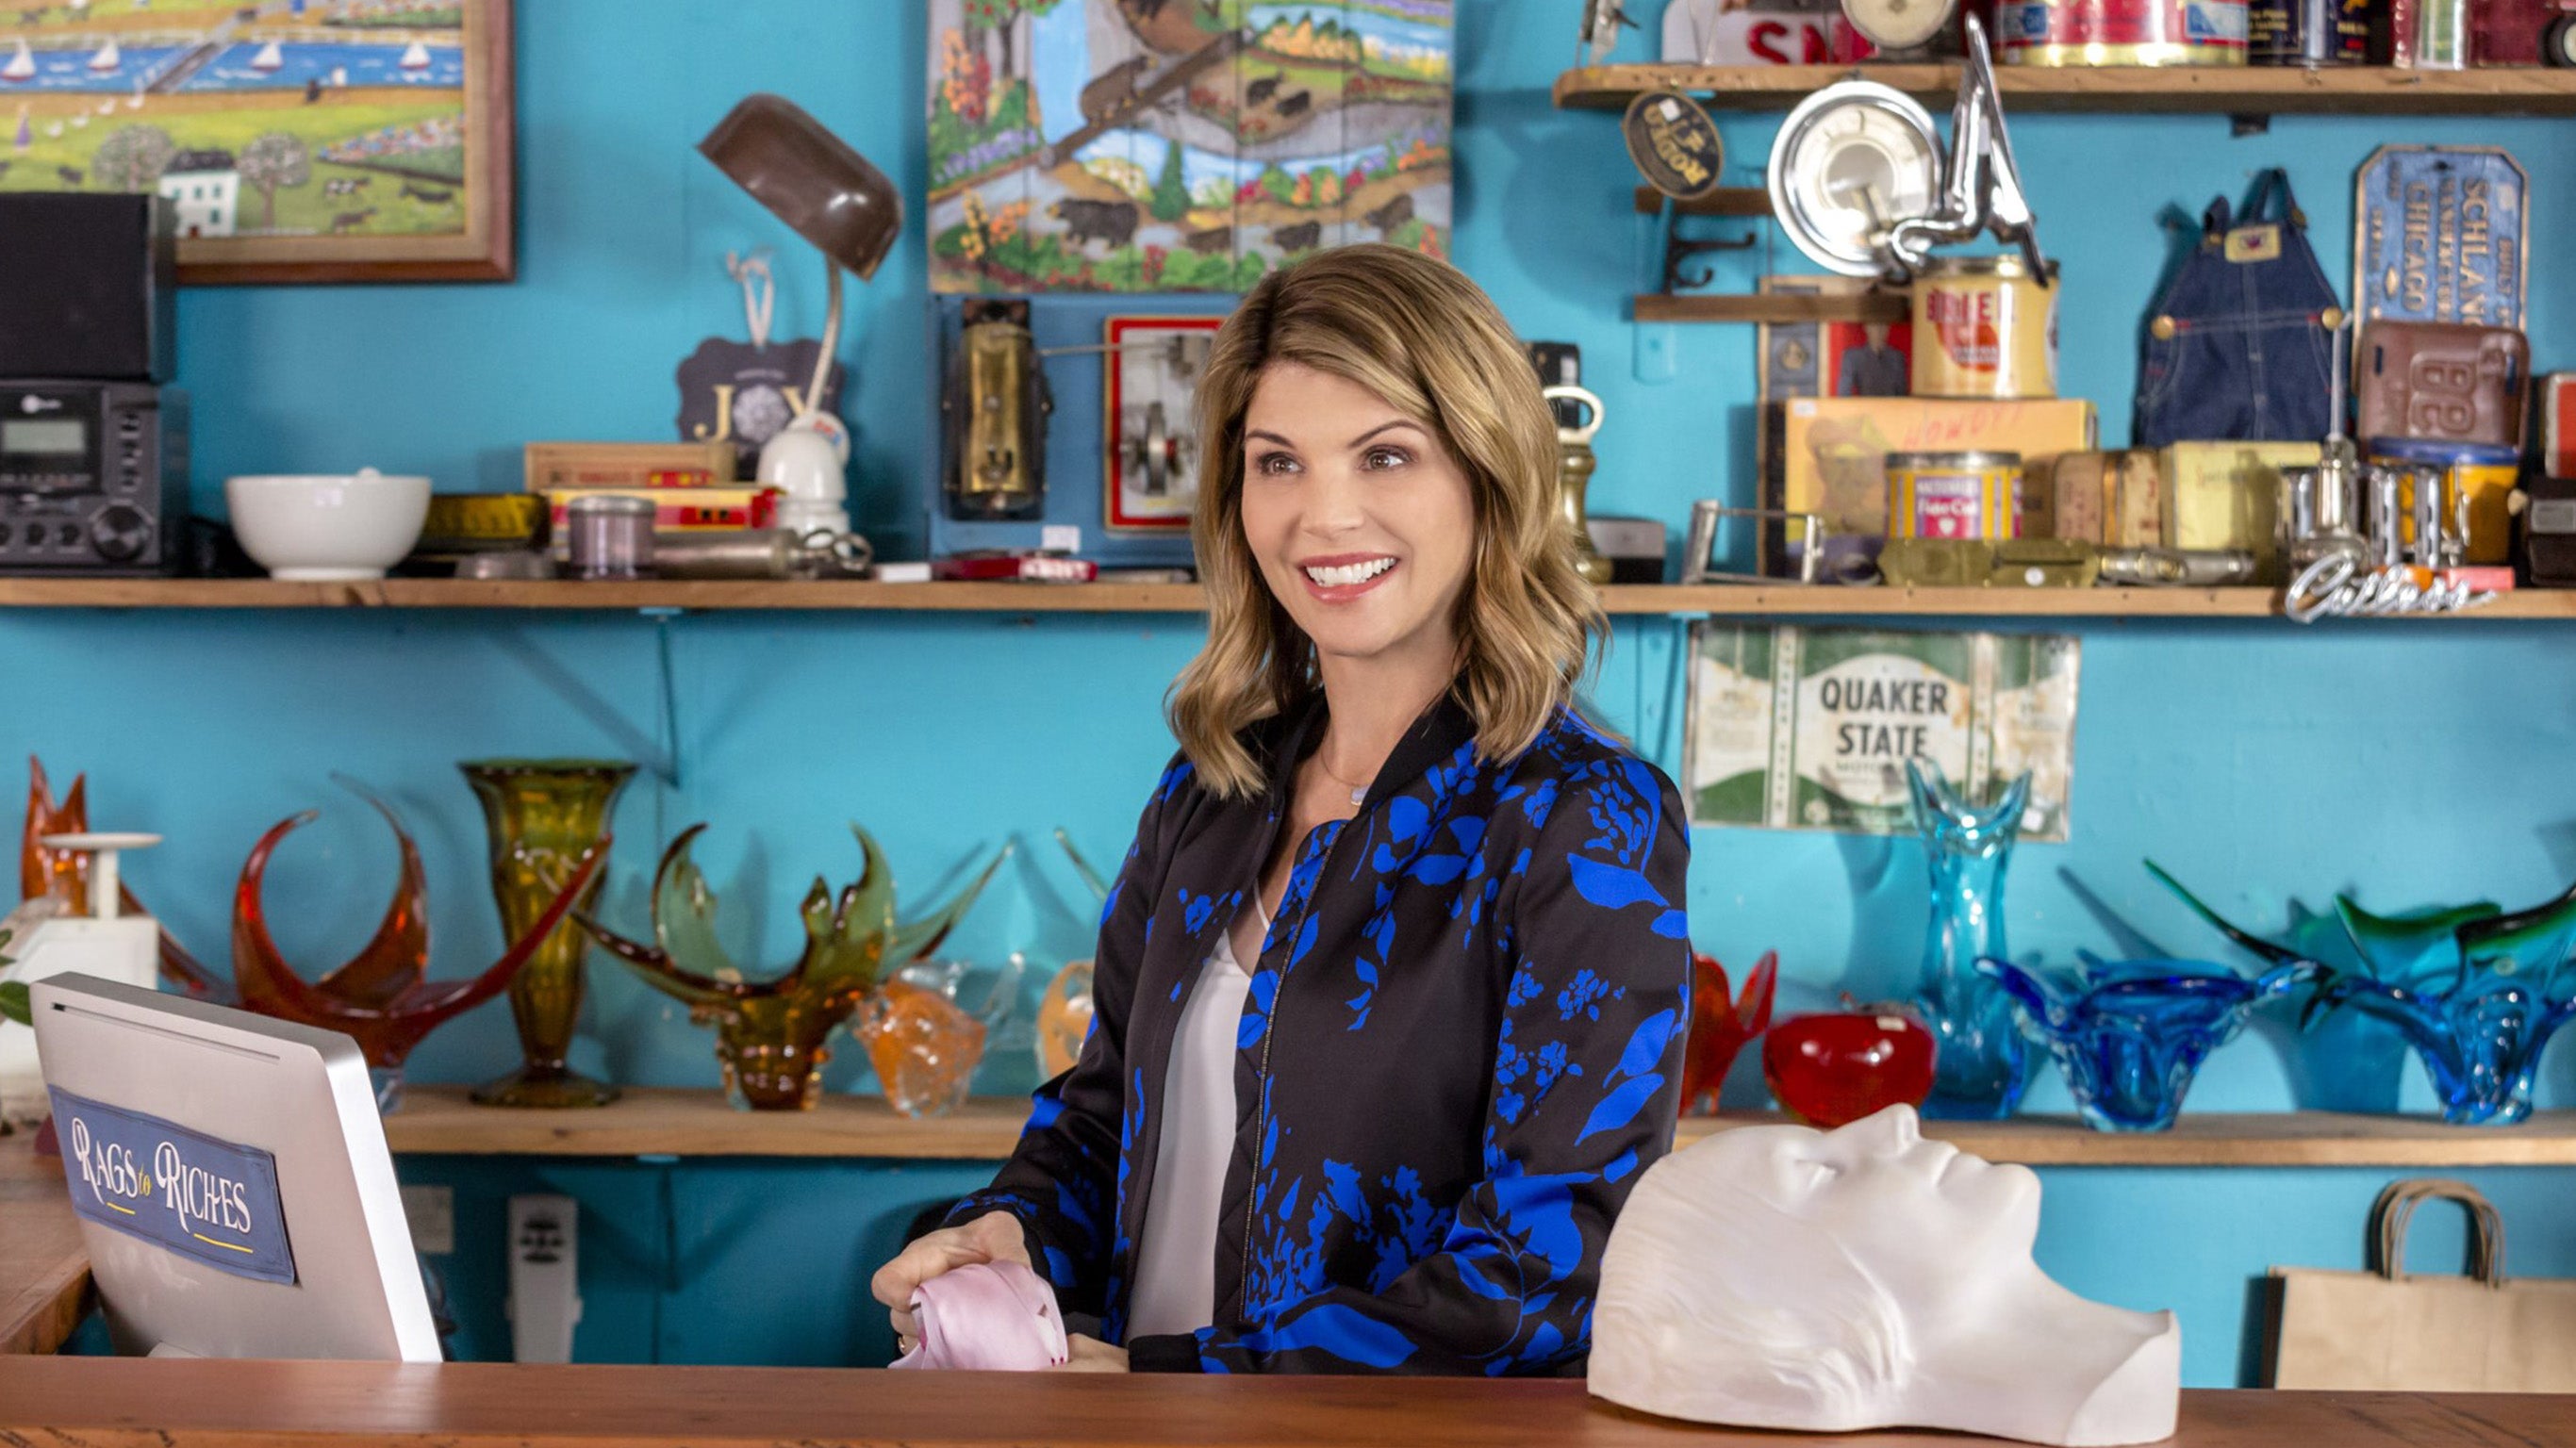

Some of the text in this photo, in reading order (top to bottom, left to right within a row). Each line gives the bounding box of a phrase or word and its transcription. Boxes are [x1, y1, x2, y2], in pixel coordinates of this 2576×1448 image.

[2403, 181, 2431, 312] CHICAGO
[1820, 678, 1948, 715] QUAKER
[1837, 723, 1928, 757] STATE
[72, 1117, 252, 1233] RAGS to RICHES
